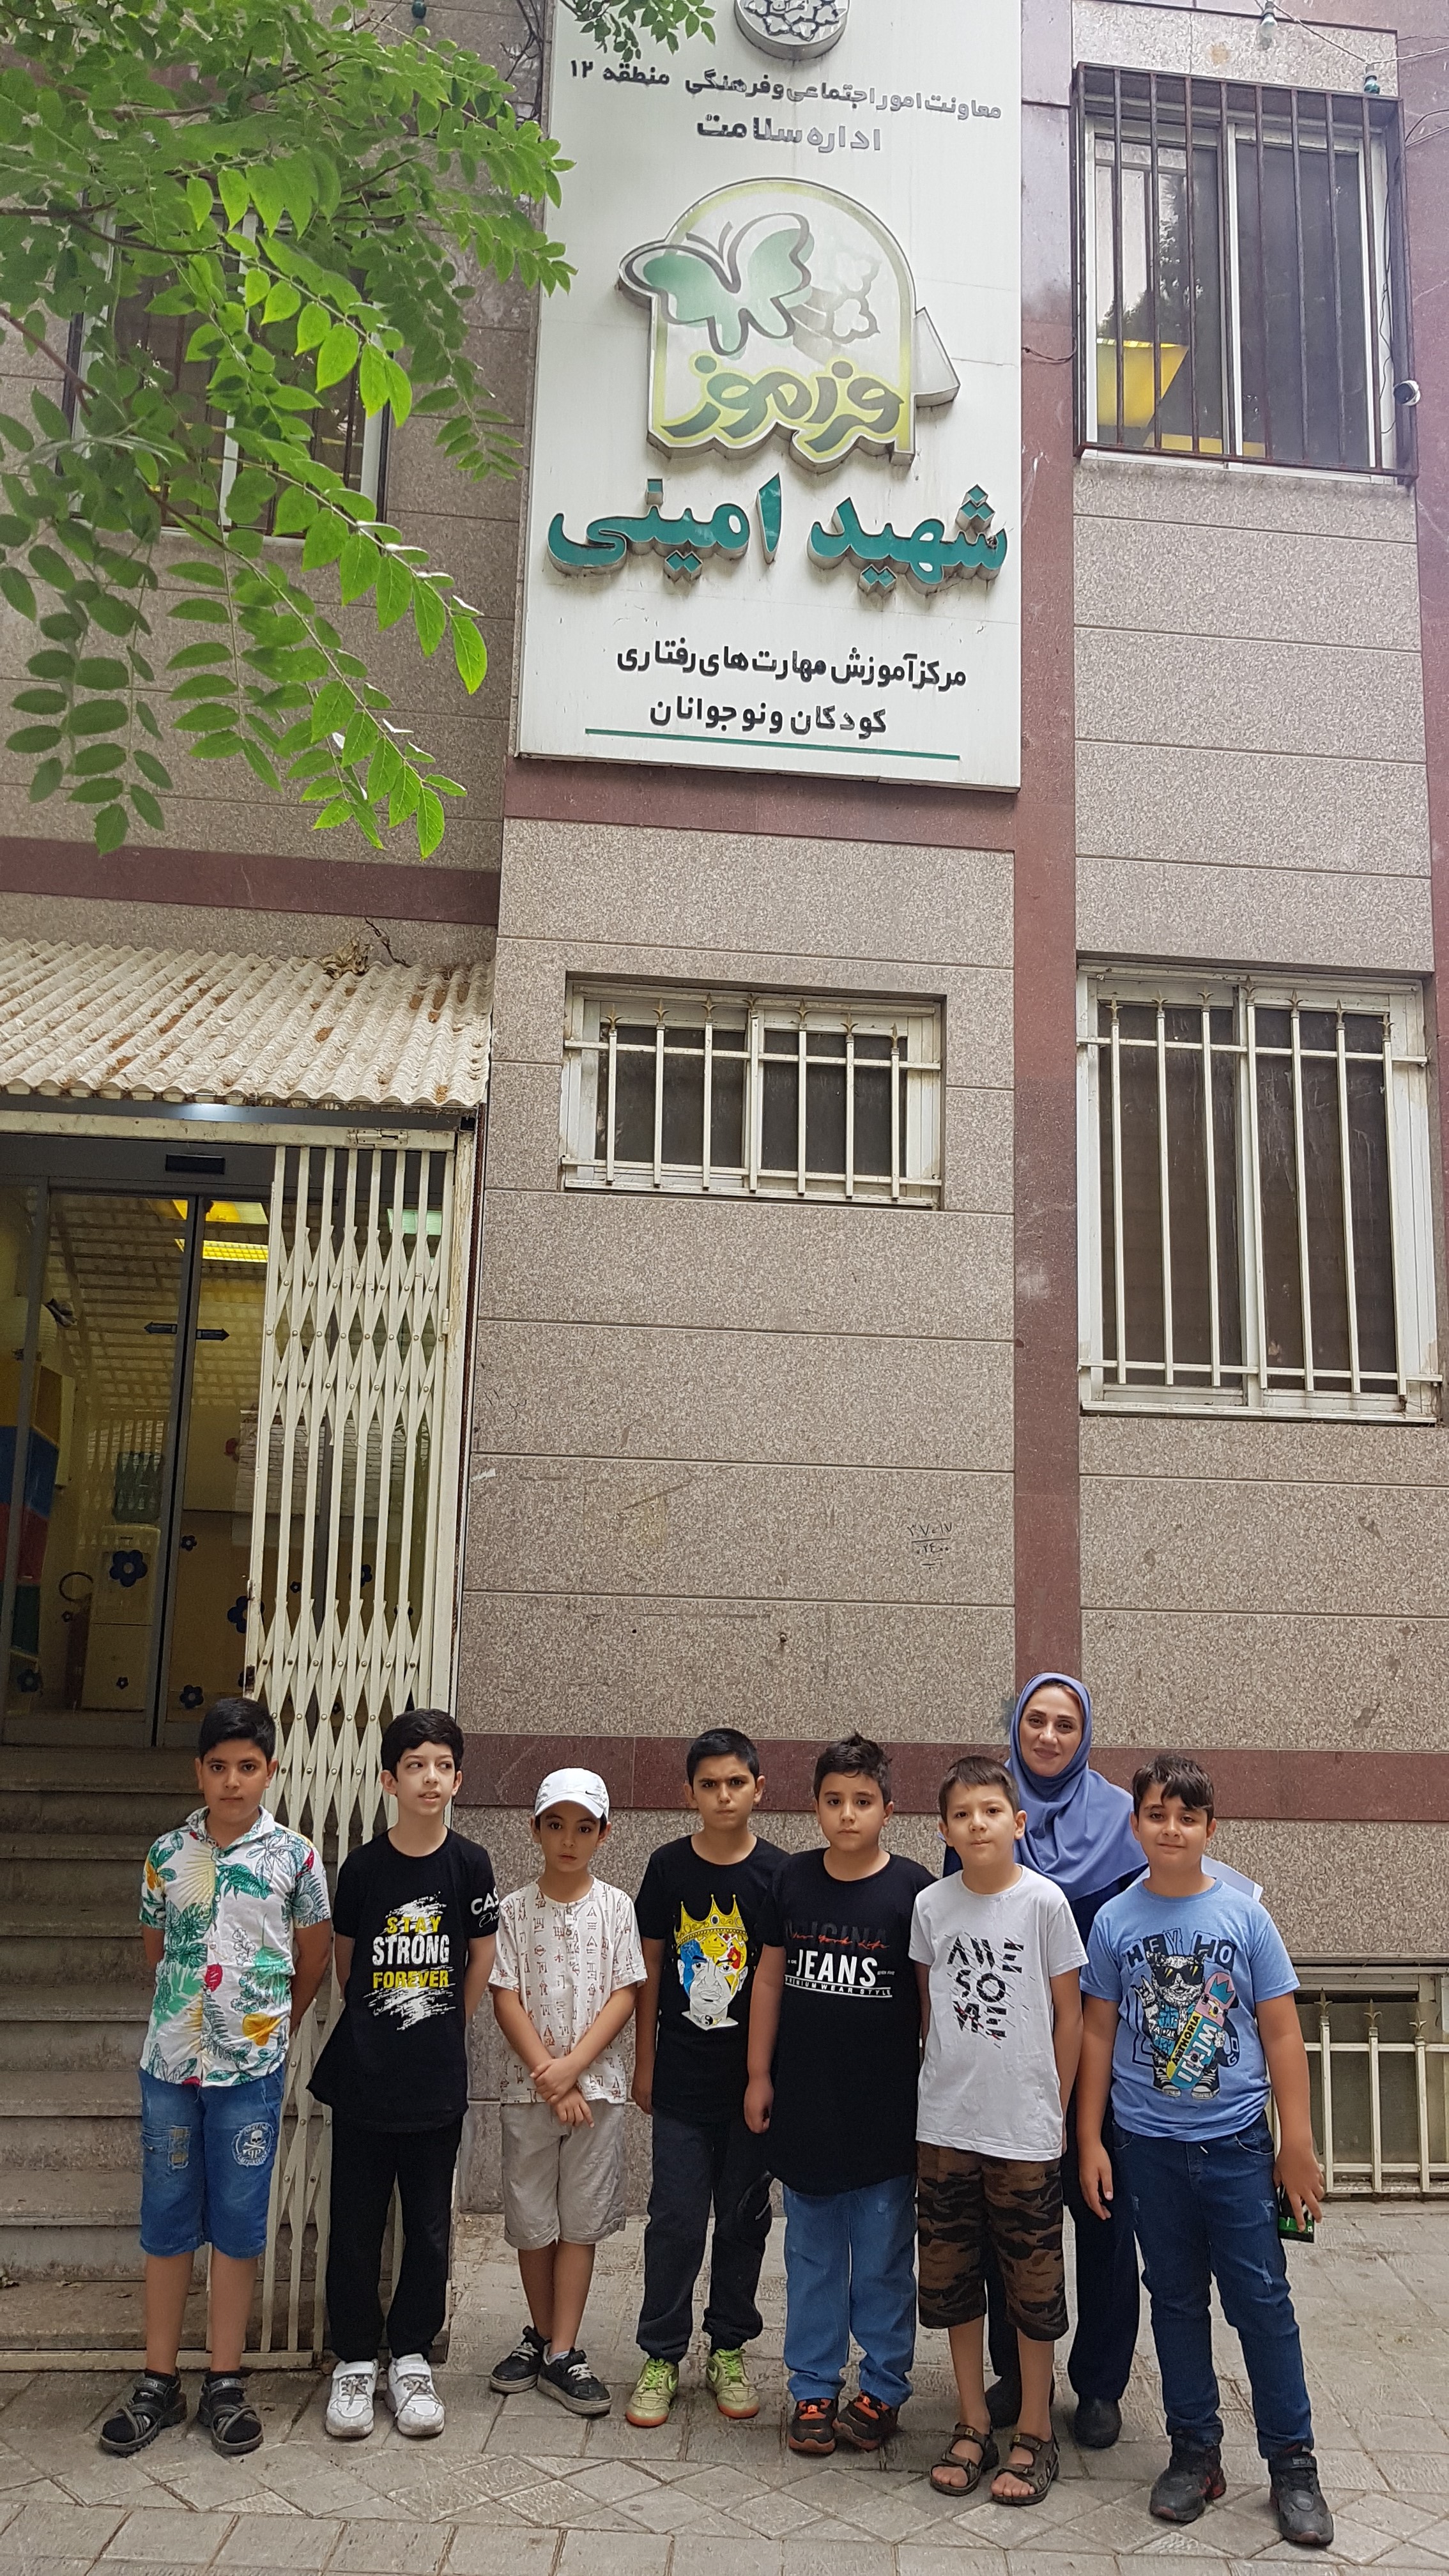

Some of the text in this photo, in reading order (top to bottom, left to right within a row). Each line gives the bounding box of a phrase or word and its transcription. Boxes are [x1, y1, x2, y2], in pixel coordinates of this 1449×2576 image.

[571, 59, 594, 79] ۱۲
[602, 63, 670, 84] منطقه
[786, 82, 875, 109] اجتماعی
[876, 92, 922, 112] امور
[924, 95, 1001, 120] معاونت
[696, 113, 881, 153] اداره سلامت
[547, 472, 1008, 590] شهید امینی
[617, 636, 696, 673] رفتاری
[831, 647, 918, 688] آموزش
[912, 660, 967, 693] مرکز
[790, 705, 887, 740] کودکان
[386, 1915, 441, 1935] STAY
[371, 1934, 450, 1966] STRONG
[1192, 1932, 1234, 1965] HO
[372, 1969, 450, 1989] FOREVER
[795, 1949, 878, 1988] JEANS
[785, 1976, 891, 1997] PREMIUM WEAR STYLE
